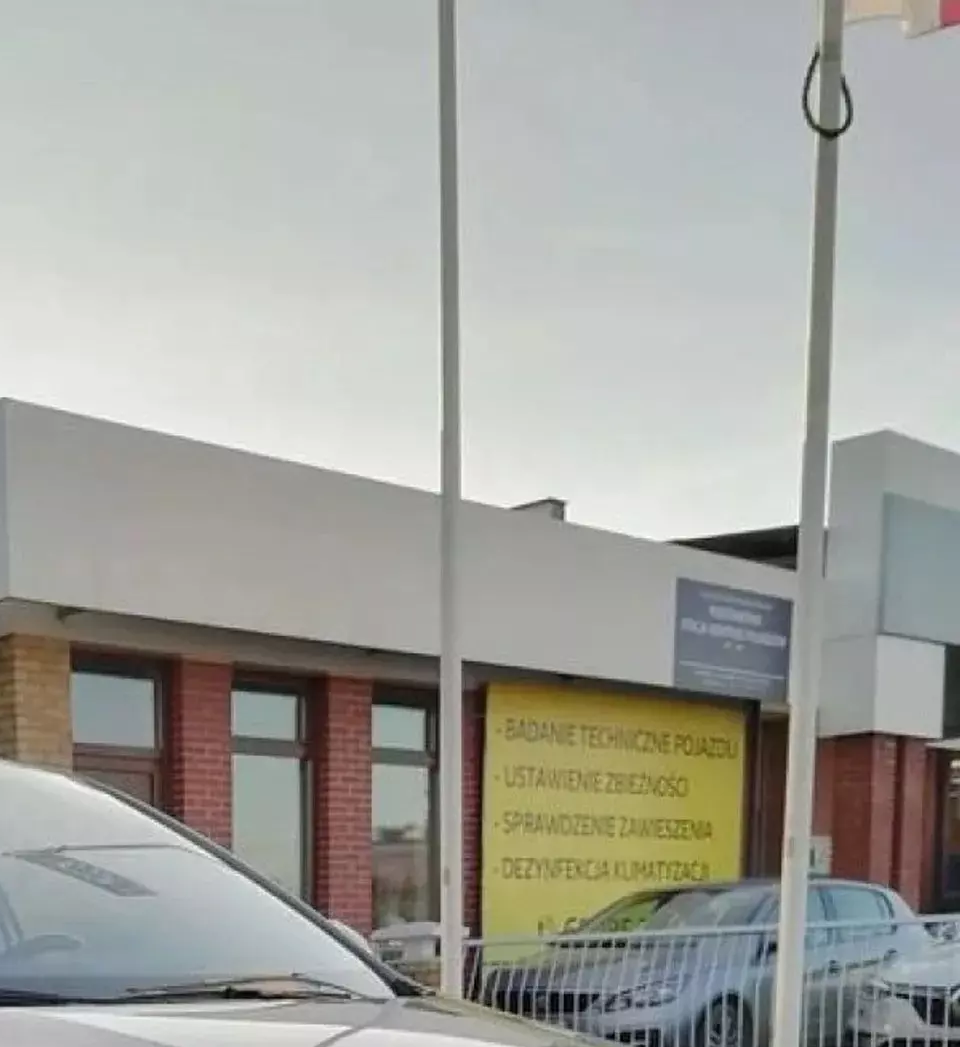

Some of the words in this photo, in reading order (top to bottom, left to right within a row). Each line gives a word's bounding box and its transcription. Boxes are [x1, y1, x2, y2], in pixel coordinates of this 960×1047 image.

[504, 718, 576, 747] BADANIE
[580, 725, 671, 755] TECHNICZNE
[503, 765, 602, 794] USTAWIENIE
[502, 811, 615, 838] SPRAWDZENIE
[619, 816, 713, 841] ZAWIESZENIA
[501, 856, 610, 882] DEZYNFEKCJA
